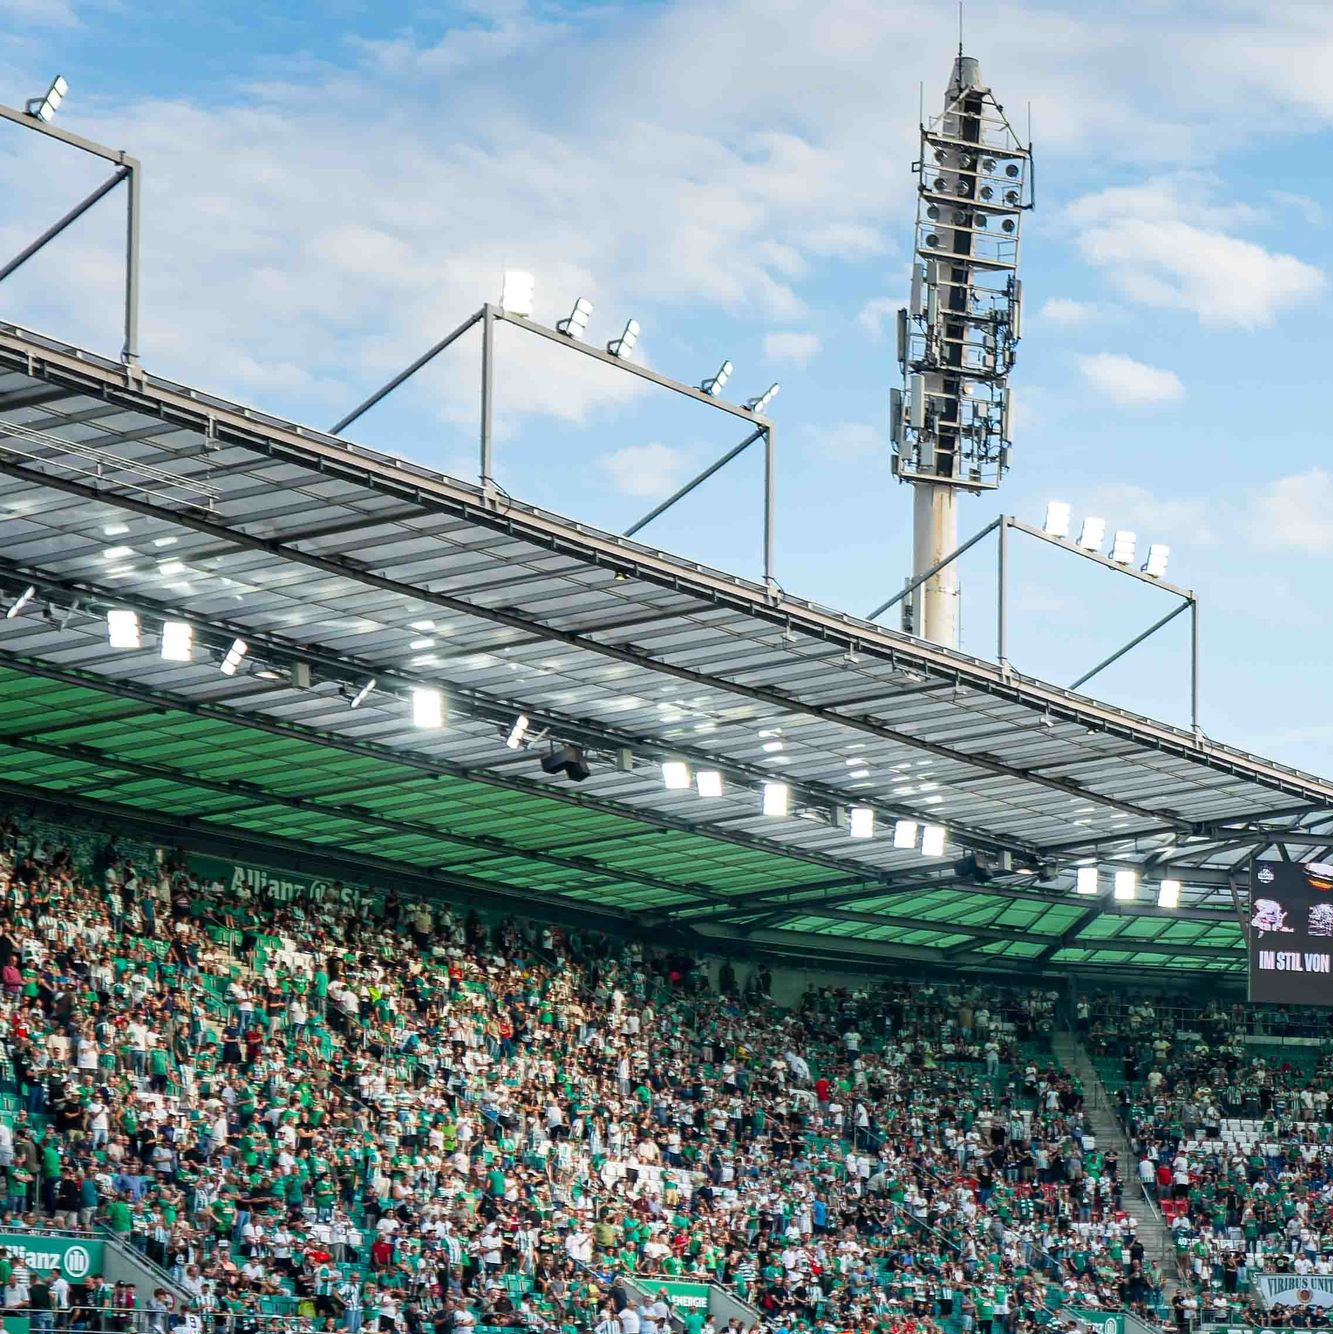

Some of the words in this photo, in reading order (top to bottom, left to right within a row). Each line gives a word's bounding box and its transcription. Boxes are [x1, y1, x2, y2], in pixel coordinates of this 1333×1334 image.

[1258, 951, 1275, 970] IM
[1276, 952, 1303, 972] STIL
[1304, 953, 1330, 973] VON
[1267, 1278, 1308, 1297] VIRIBUS
